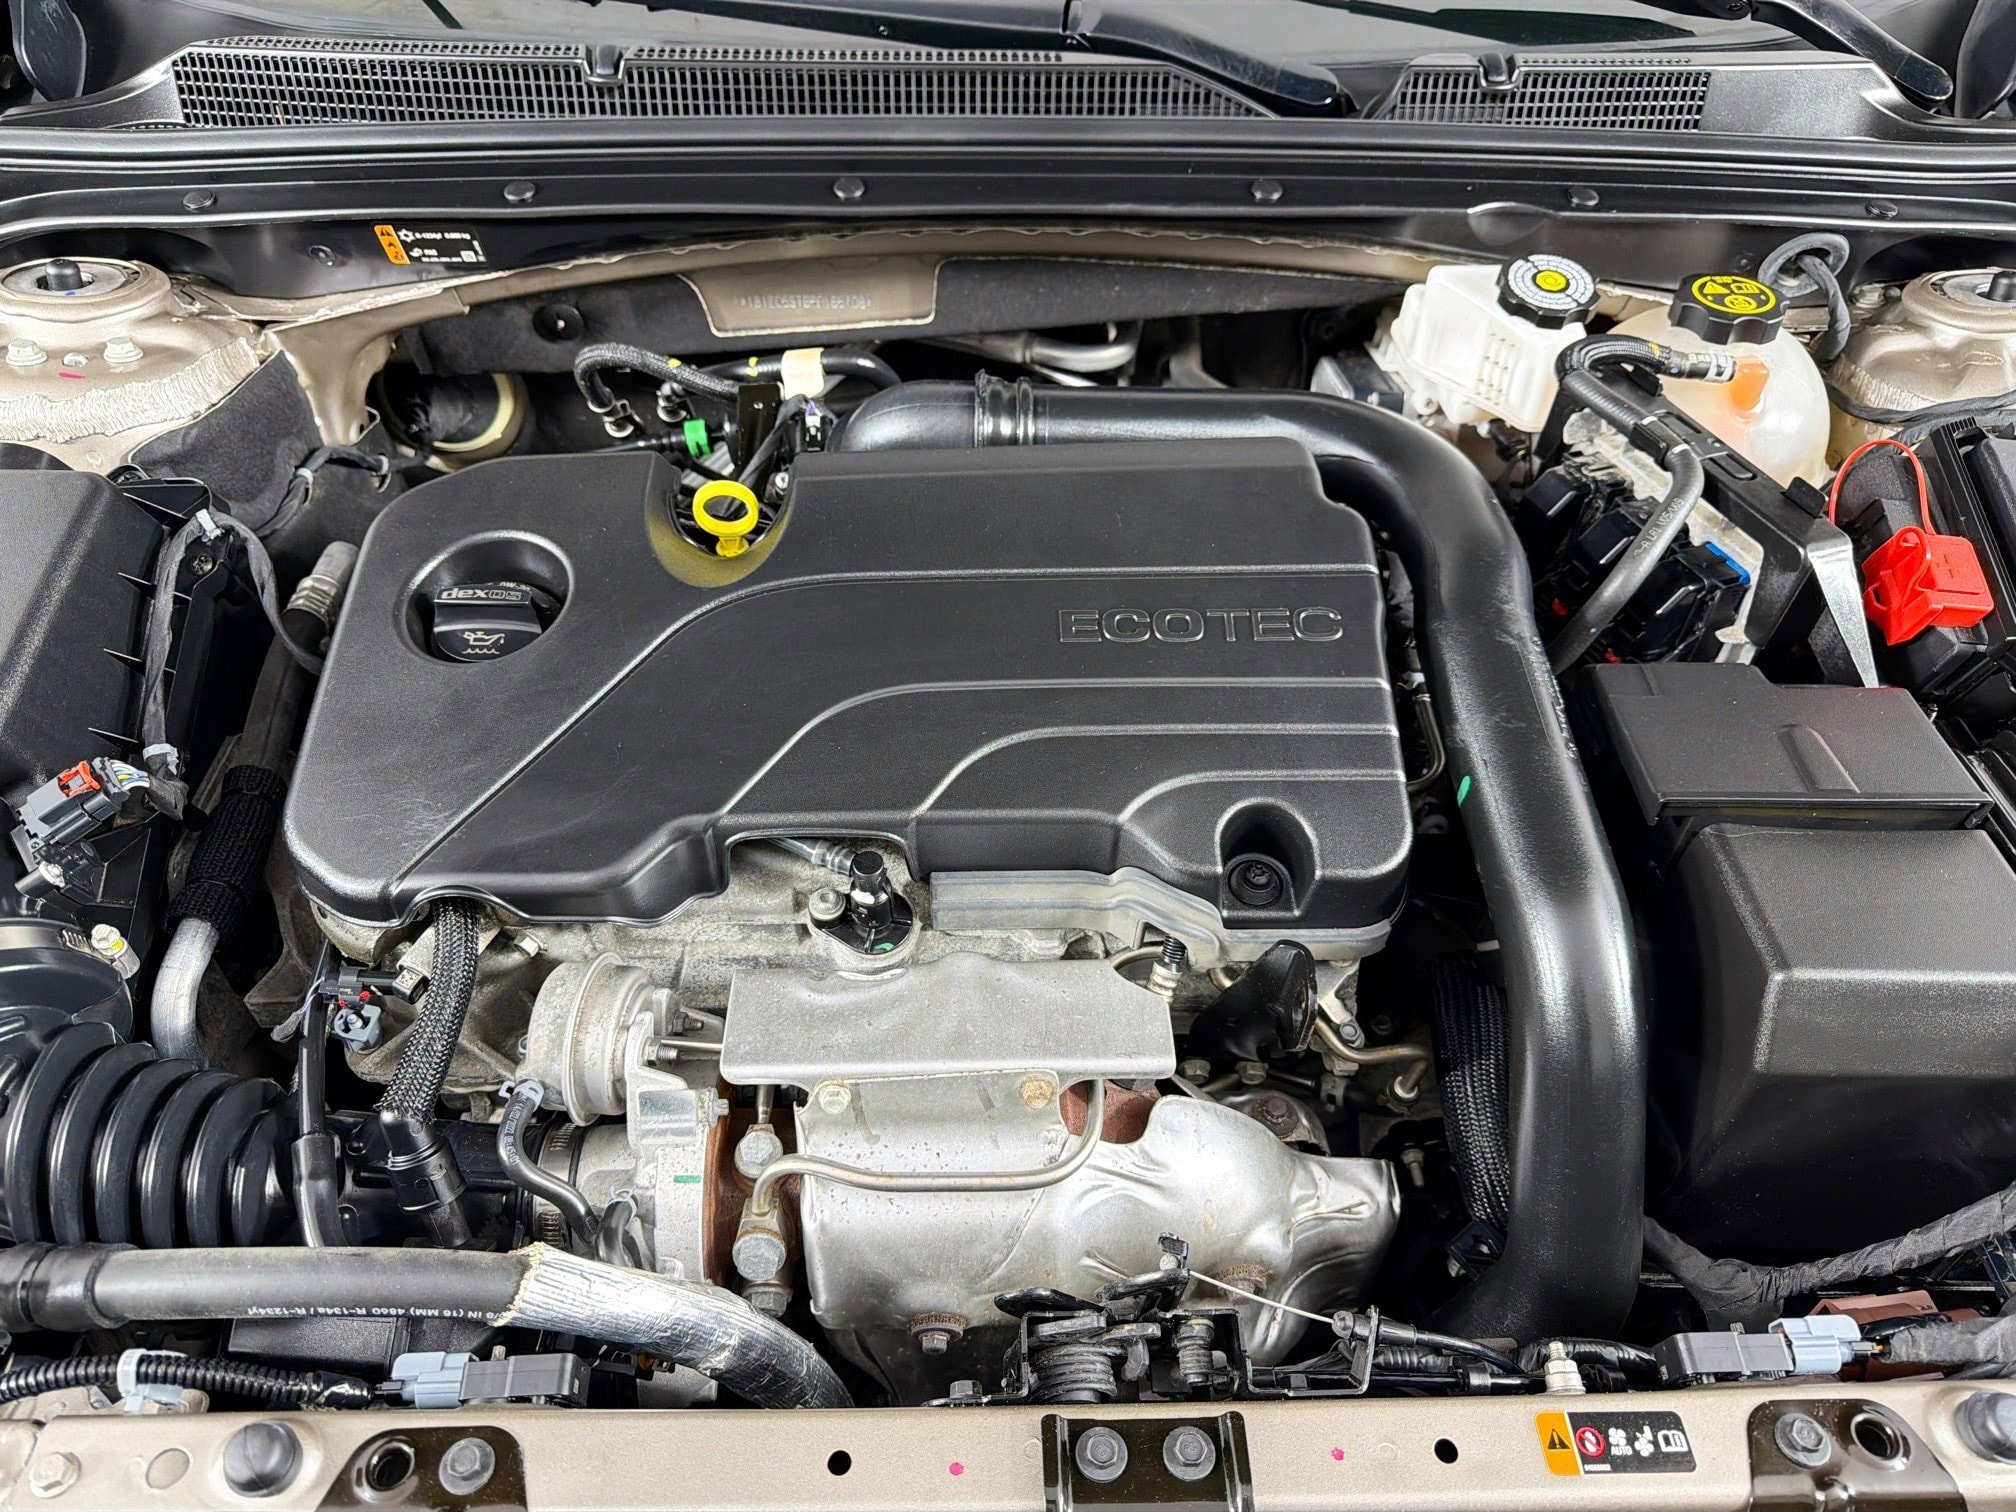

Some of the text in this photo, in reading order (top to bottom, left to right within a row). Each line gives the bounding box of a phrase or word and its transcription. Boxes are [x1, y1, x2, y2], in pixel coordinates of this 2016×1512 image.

[441, 587, 523, 601] dexos
[1058, 606, 1344, 642] ECOTEC
[316, 1307, 367, 1315] R-134a
[409, 1306, 439, 1317] MM)
[467, 1310, 482, 1319] IN
[1610, 1445, 1633, 1456] AUTO
